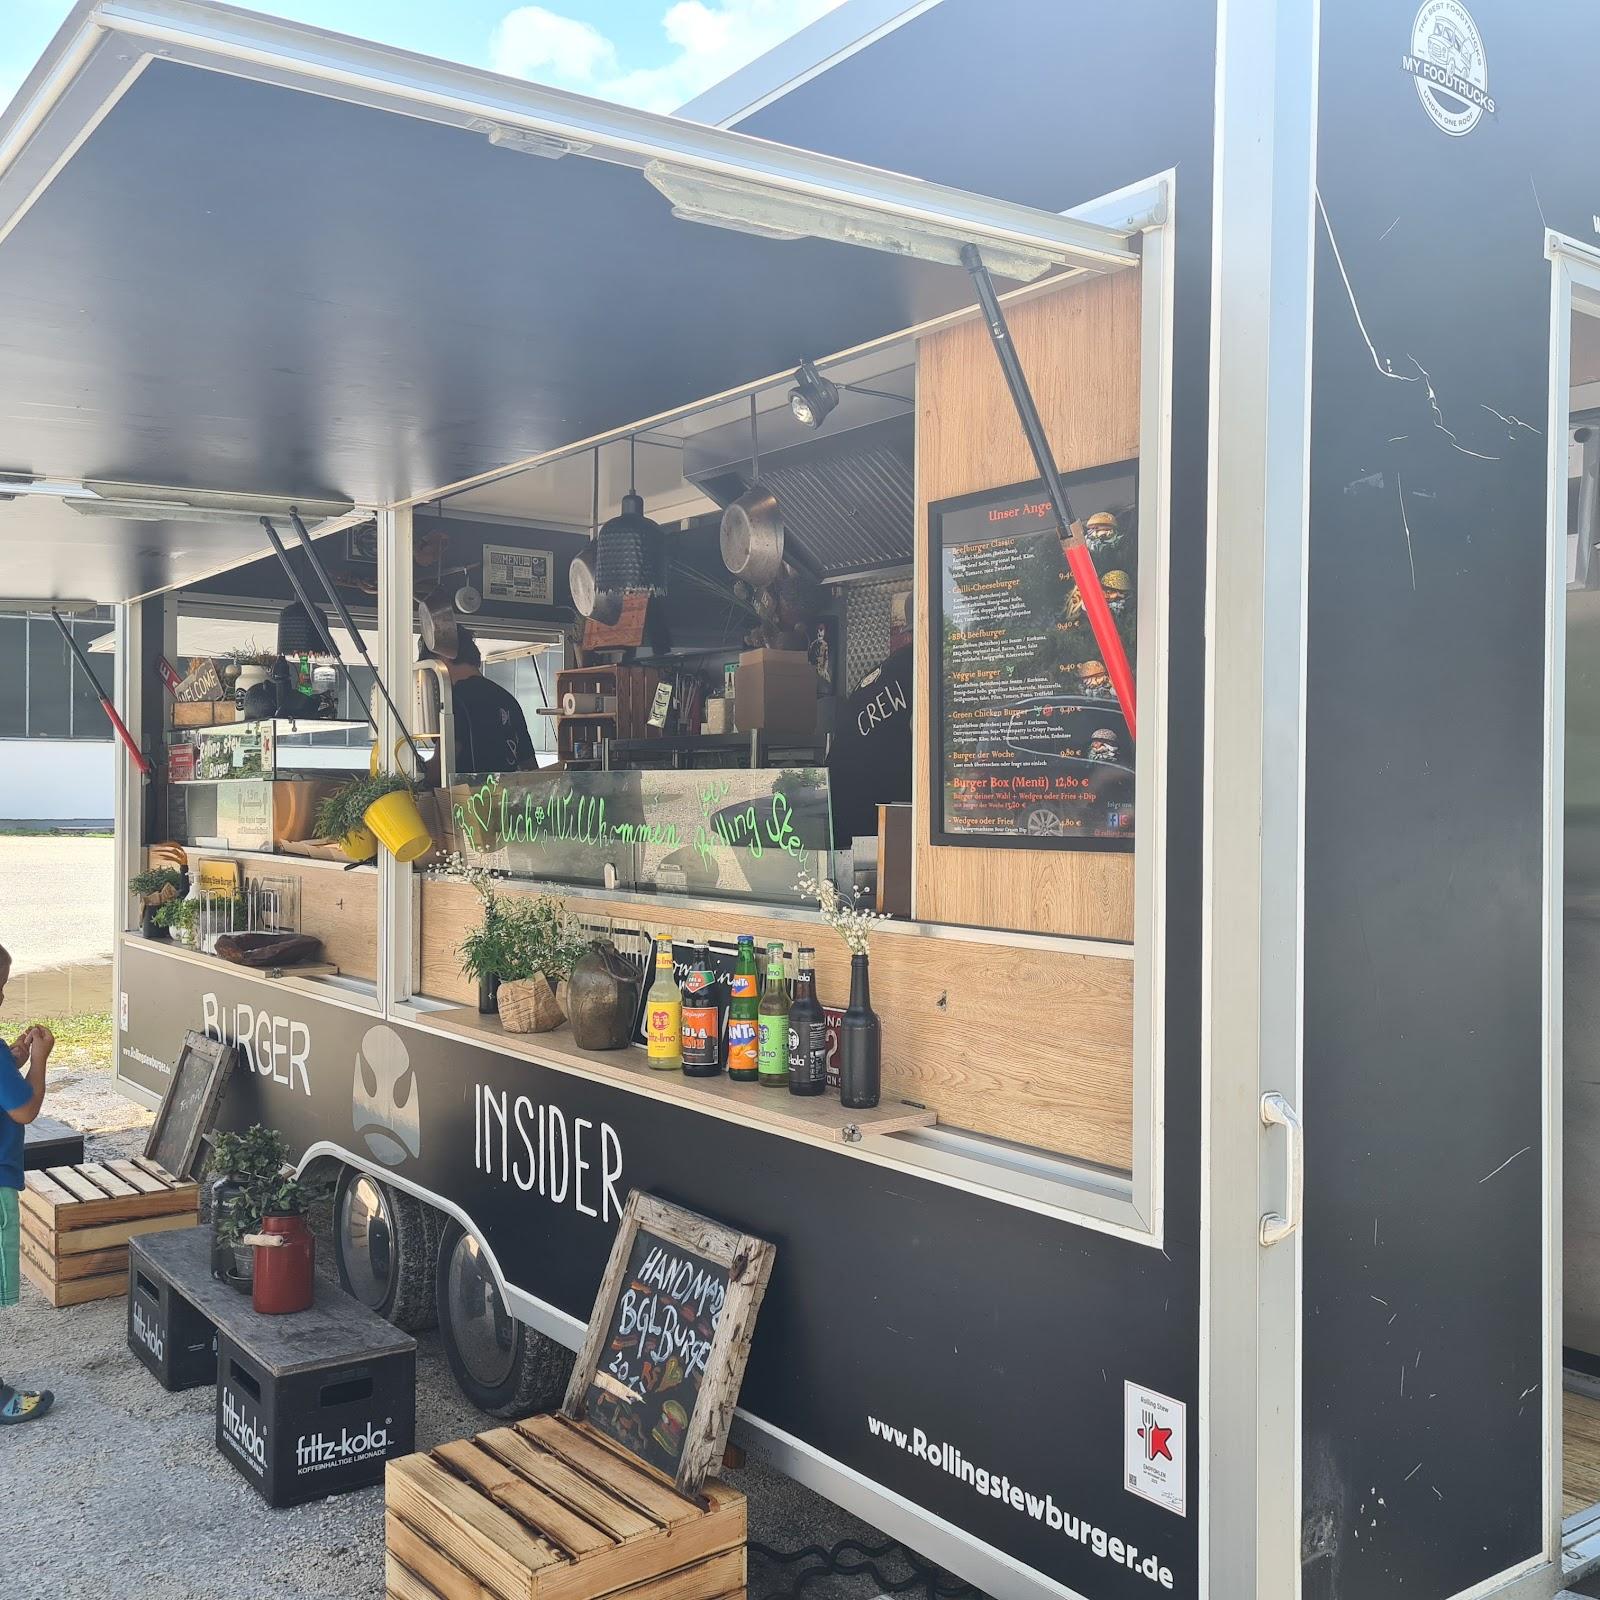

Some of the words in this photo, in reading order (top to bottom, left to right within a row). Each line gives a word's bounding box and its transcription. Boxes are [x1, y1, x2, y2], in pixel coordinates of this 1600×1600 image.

[1428, 3, 1444, 16] BEST
[1446, 3, 1482, 66] FOODTRUCKS
[1401, 55, 1421, 74] MY
[1423, 61, 1496, 113] FOODTRUCKS
[1424, 90, 1442, 120] UNDER
[1444, 117, 1457, 126] ONE
[1458, 111, 1473, 126] ROOF
[989, 506, 1019, 522] Unser
[1023, 501, 1052, 518] Ange
[991, 538, 1015, 548] Classic
[502, 554, 524, 566] MENU
[967, 629, 1006, 639] Beefburger
[177, 668, 217, 702] WELCOME
[953, 671, 976, 682] Veggie
[977, 669, 1001, 680] Burger
[857, 680, 907, 736] CREW
[952, 709, 973, 719] Green
[974, 708, 1002, 718] Chicken
[1004, 707, 1028, 718] Burger
[953, 752, 976, 762] Burger
[978, 750, 989, 759] der
[991, 750, 1015, 758] Woche
[953, 777, 987, 792] Burger
[990, 776, 1009, 788] Box
[1012, 776, 1049, 792] (Menü)
[1055, 776, 1078, 788] 12,80
[1081, 778, 1089, 787] €
[953, 793, 973, 802] Burger
[974, 792, 994, 800] deiner
[995, 792, 1011, 800] Wahl
[1019, 792, 1043, 802] Wedges
[1044, 792, 1059, 800] oder
[1060, 792, 1077, 800] Fries
[952, 817, 978, 827] Wedges
[979, 817, 996, 825] oder
[997, 817, 1014, 826] Fries
[729, 1024, 756, 1040] ANTA
[203, 992, 312, 1096] BURGER
[475, 1083, 624, 1222] INSIDER
[1157, 1402, 1169, 1413] Stew
[223, 1387, 265, 1464] fritz-kola
[296, 1421, 387, 1466] fritz-kola
[297, 1456, 353, 1475] KOFFEINHALTIGE
[354, 1448, 387, 1462] LIMONADE
[868, 1416, 1173, 1589] www.Rollingstewburger.de
